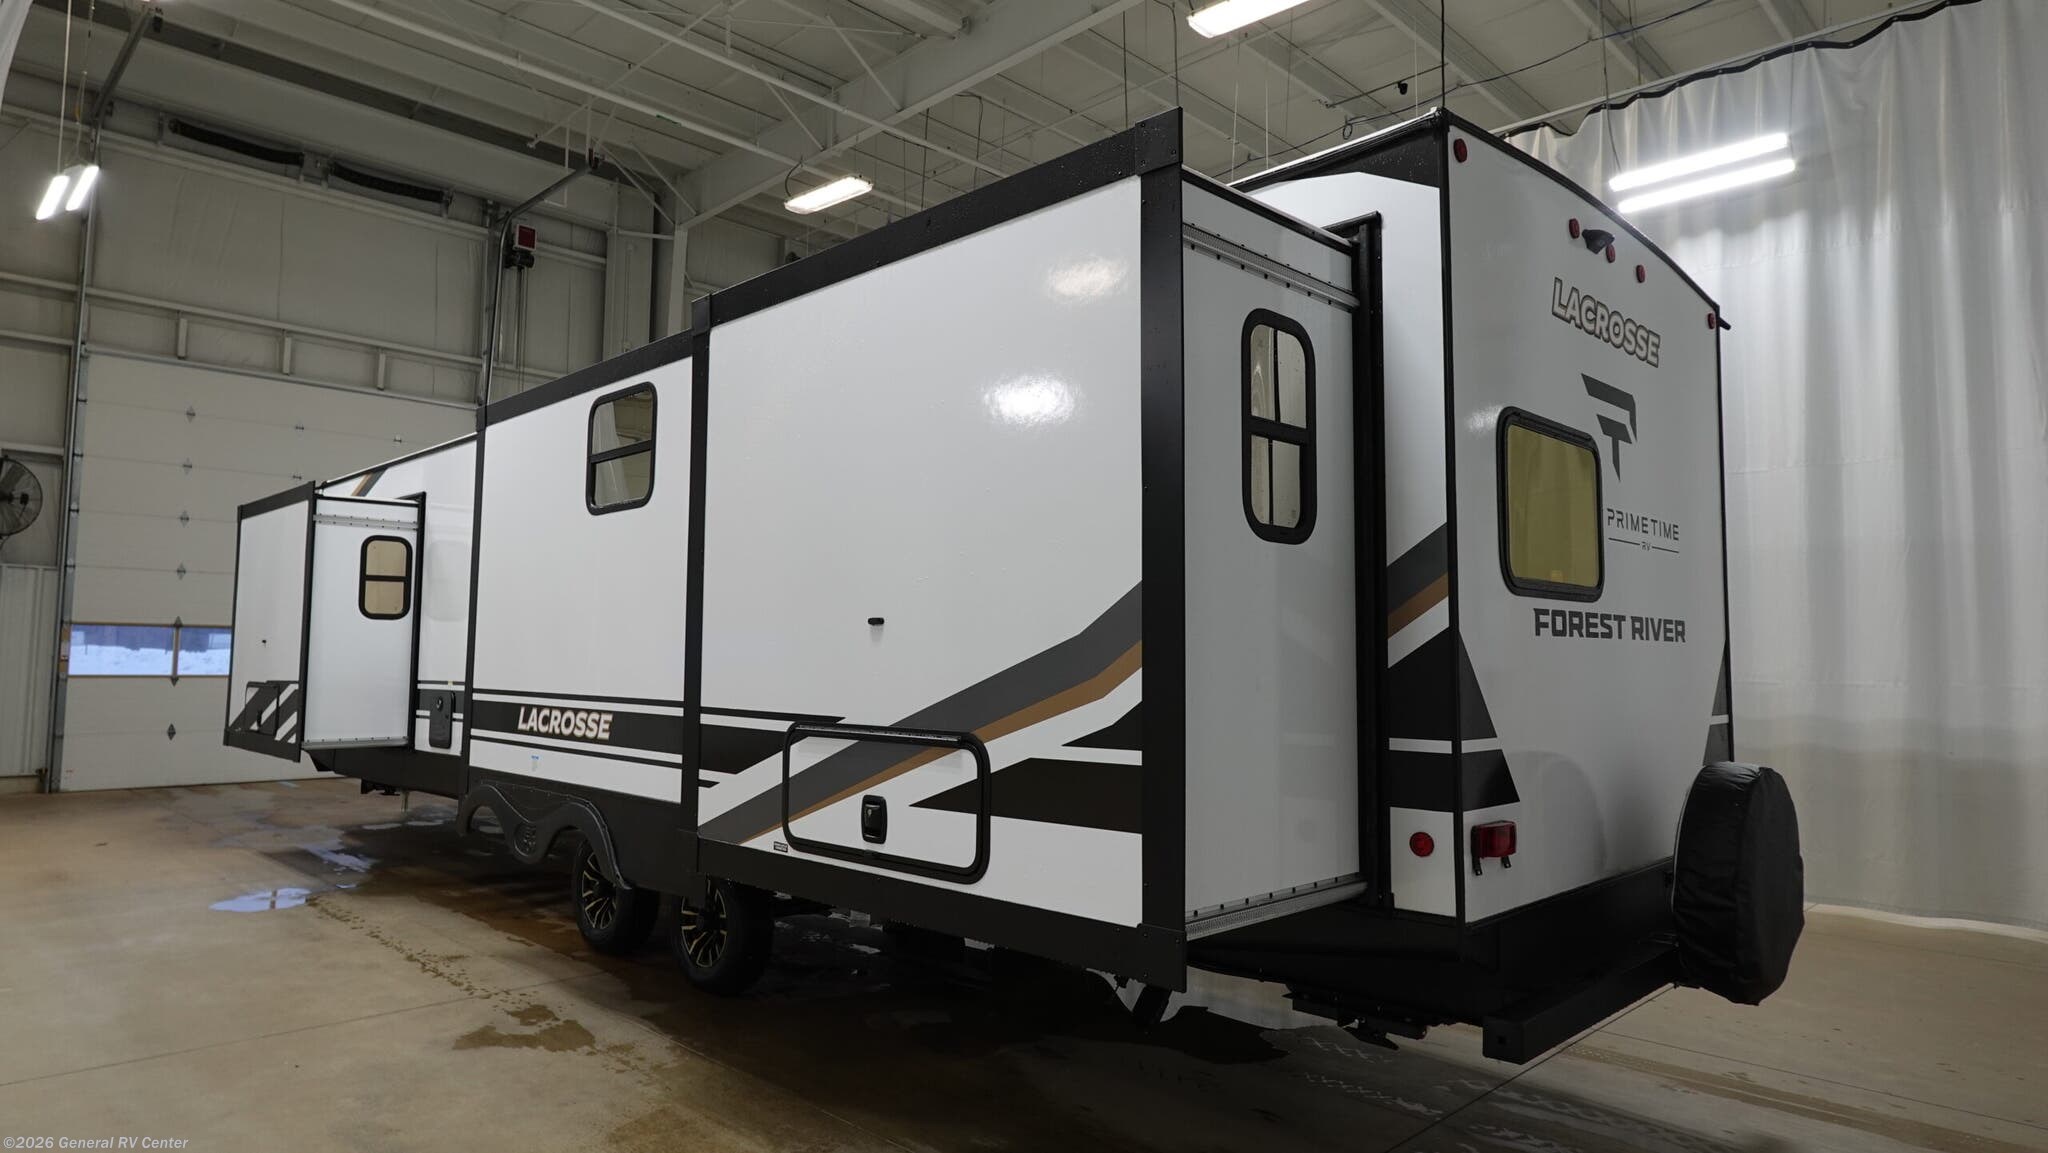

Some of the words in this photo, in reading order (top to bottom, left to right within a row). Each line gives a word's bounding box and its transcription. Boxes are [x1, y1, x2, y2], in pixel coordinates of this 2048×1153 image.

[1552, 277, 1661, 367] LACROSSE
[1642, 541, 1651, 550] RV
[1534, 608, 1626, 640] FOREST
[1631, 615, 1686, 643] RIVER
[517, 706, 613, 740] LACROSSE
